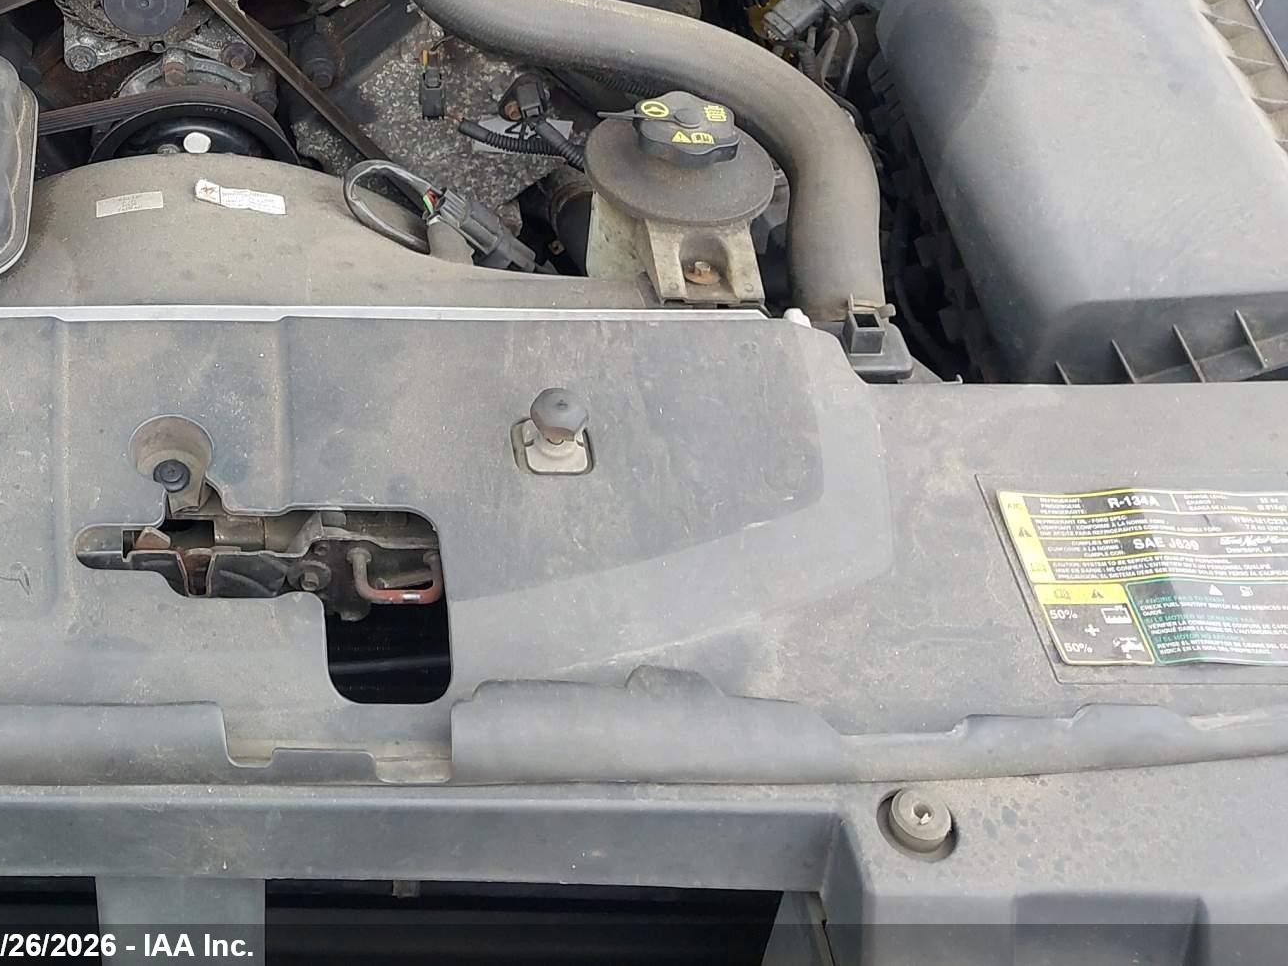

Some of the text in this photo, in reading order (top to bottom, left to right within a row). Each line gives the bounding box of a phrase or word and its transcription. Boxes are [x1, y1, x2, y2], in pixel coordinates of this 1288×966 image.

[1107, 495, 1160, 509] R-134A
[1133, 537, 1165, 549] SAE
[1050, 609, 1077, 619] 50%
[1064, 642, 1093, 653] 50%
